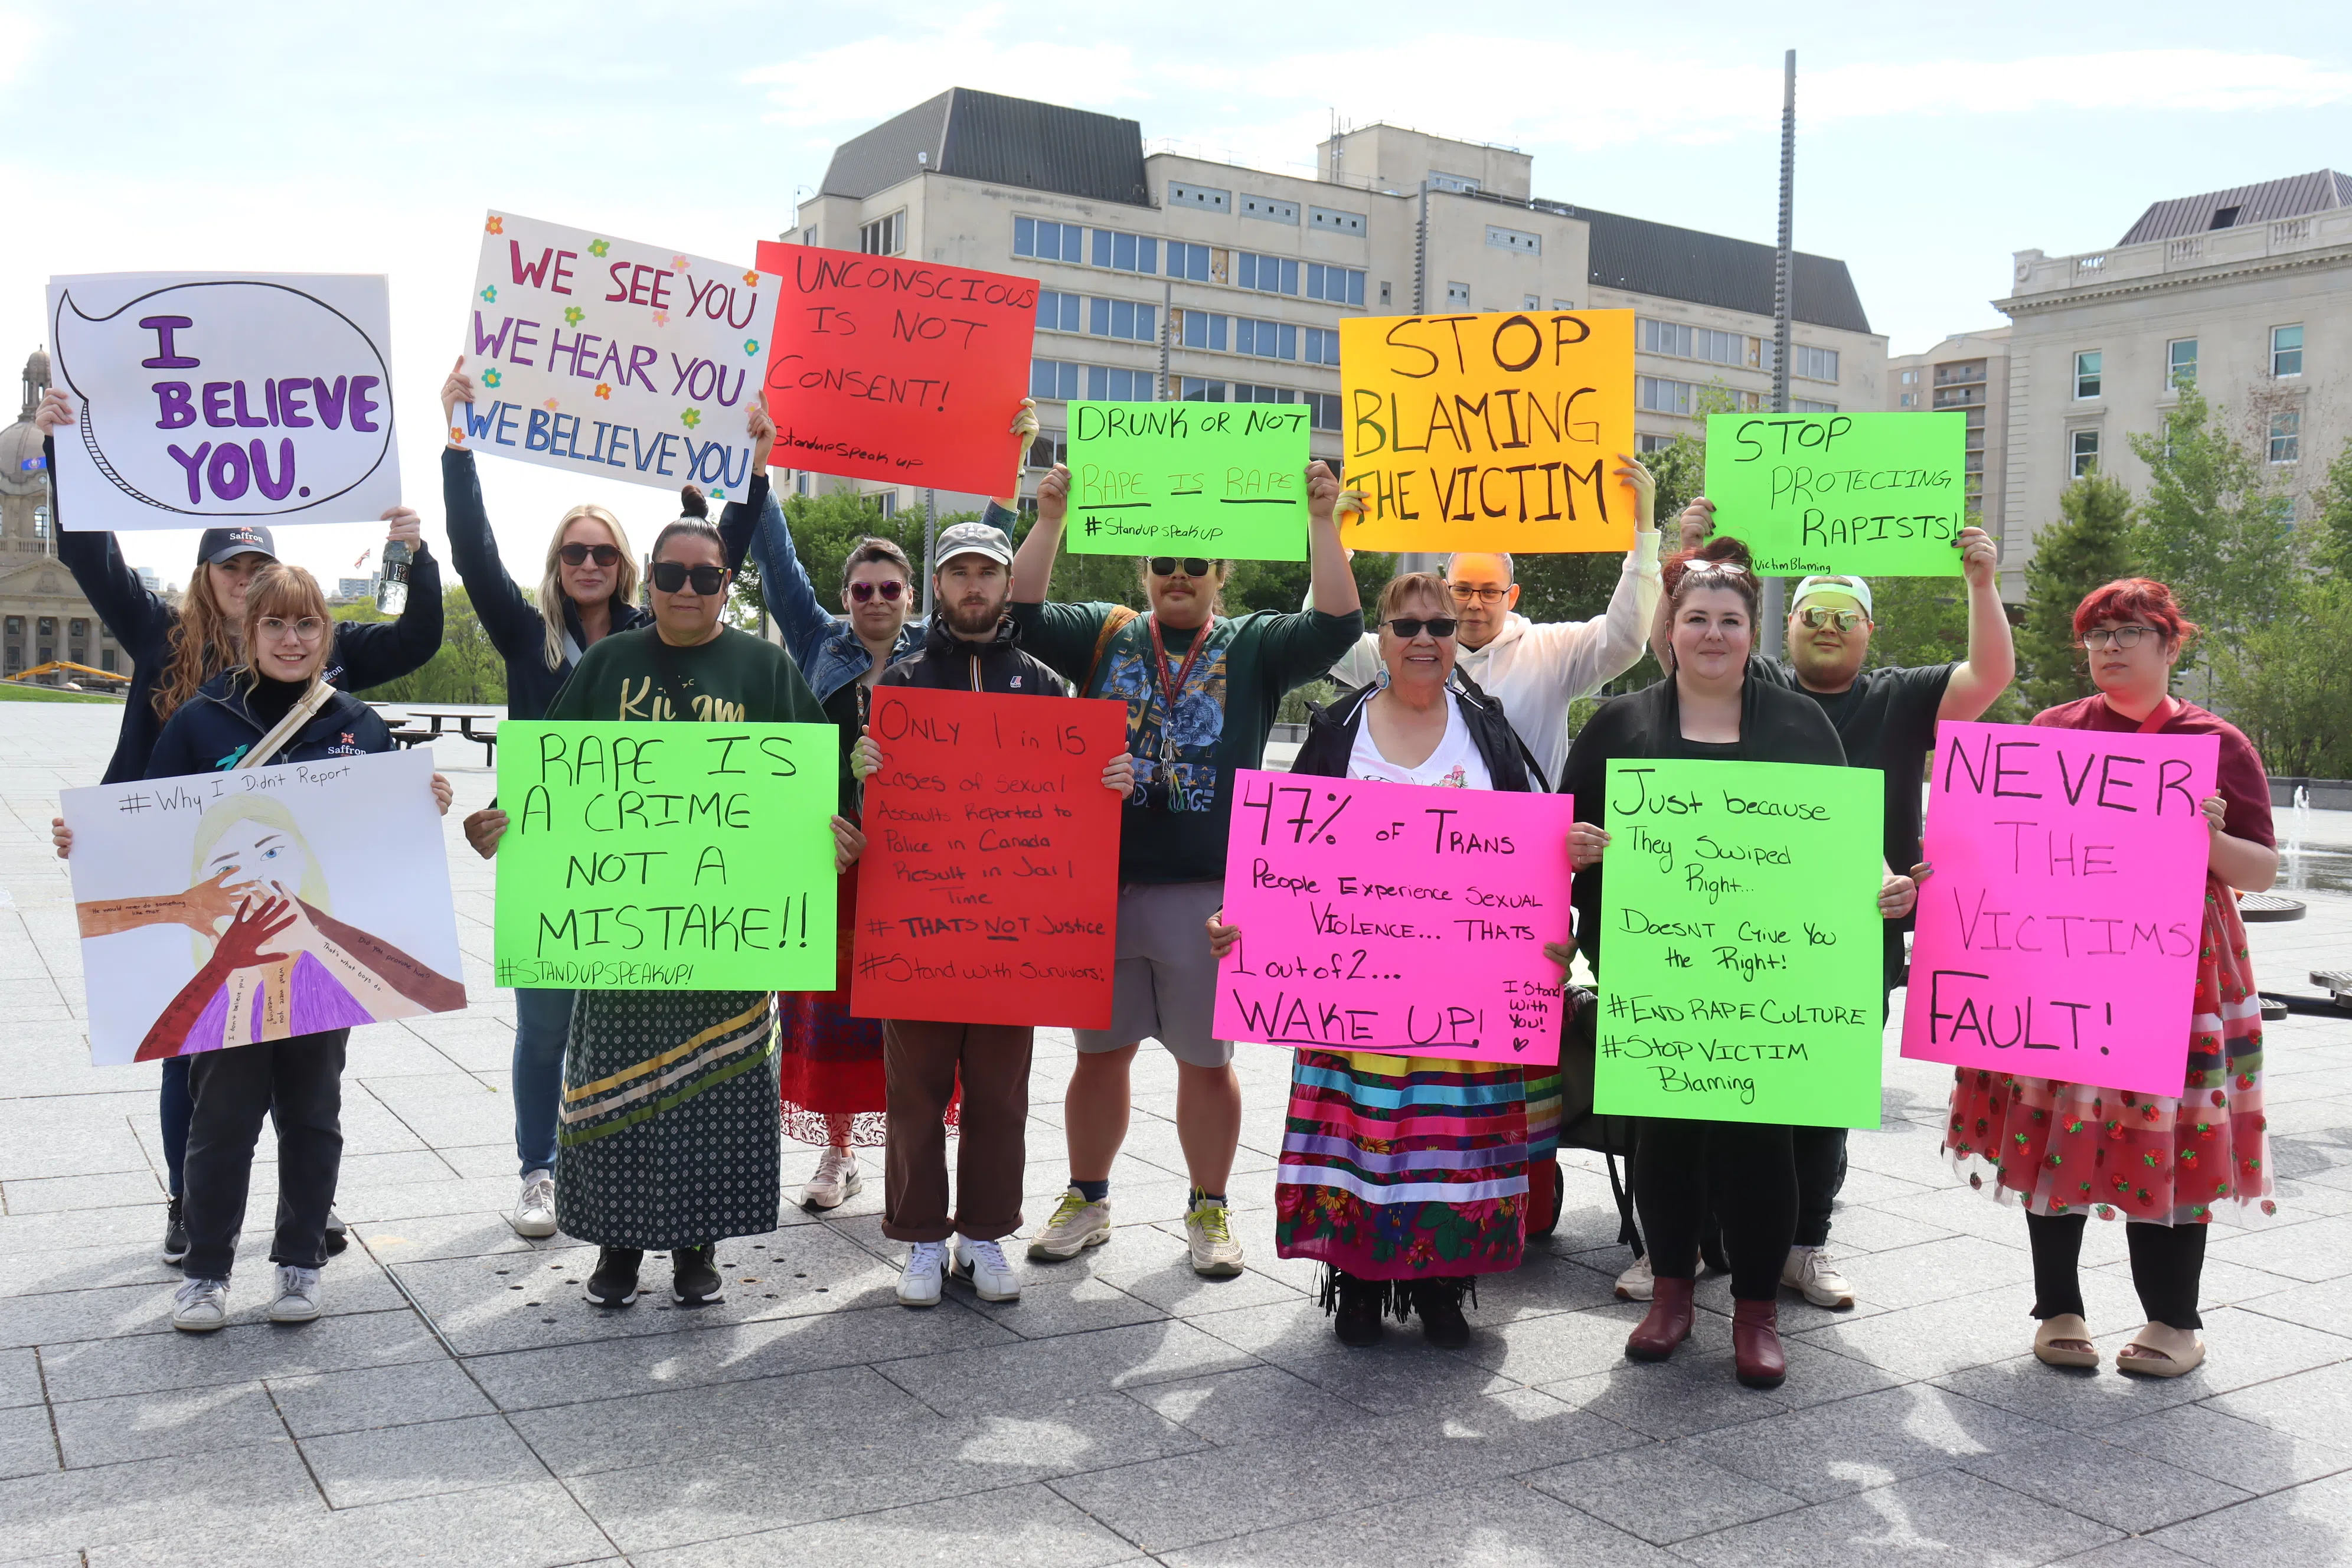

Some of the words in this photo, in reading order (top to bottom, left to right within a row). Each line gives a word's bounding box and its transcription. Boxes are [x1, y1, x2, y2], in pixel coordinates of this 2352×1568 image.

[509, 239, 578, 296] WE
[605, 261, 675, 310] SEE
[686, 274, 757, 329] YOU
[796, 255, 1035, 309] UNCONSCIOUS
[139, 315, 201, 368] I
[806, 306, 856, 335] IS
[893, 309, 989, 350] NOT
[1386, 314, 1591, 378] STOP
[474, 310, 541, 367] WE
[548, 328, 658, 393] HEAR
[671, 352, 746, 407] YOU
[767, 354, 950, 412] CONSENT!
[151, 374, 380, 433] BELIEVE
[1077, 406, 1188, 441] DRUNK
[1201, 411, 1231, 435] OR
[1244, 409, 1308, 436] NOT
[1353, 387, 1600, 458] BLAMING
[465, 400, 522, 446] WE
[525, 408, 681, 476] BELIEVE
[683, 436, 750, 489] YOU
[1733, 416, 1853, 462] STOP
[167, 437, 311, 505] YOU.
[1082, 463, 1148, 505] RAPE
[1167, 472, 1205, 492] IS
[1226, 466, 1296, 496] RAPE
[1346, 469, 1420, 527] THE
[1429, 458, 1610, 525] VICTIM
[230, 532, 264, 543] Saffron
[1802, 508, 1958, 548] RAPISTS!
[328, 744, 367, 756] Saffron
[879, 699, 961, 747] ONLY
[1056, 723, 1086, 756] 15
[211, 779, 225, 798] I
[296, 764, 352, 788] Report
[539, 733, 665, 792] RAPE
[706, 736, 797, 777] IS
[959, 772, 983, 792] of
[1944, 733, 2196, 817] NEVER
[521, 785, 551, 835] A
[584, 790, 752, 833] CRIME
[877, 800, 952, 823] Assaults
[1054, 803, 1073, 818] to
[1243, 779, 1353, 846] 47%
[1723, 789, 1832, 822] because
[883, 828, 933, 854] Police
[948, 837, 966, 851] in
[978, 828, 1051, 852] Canada
[1625, 825, 1674, 874] They
[1694, 835, 1792, 866] Swiped
[1993, 820, 2118, 877] THE
[566, 851, 669, 889] NOT
[694, 845, 727, 887] A
[982, 865, 1002, 878] in
[1252, 858, 1322, 894] People
[1337, 876, 1453, 901] Experience
[155, 900, 187, 909] something
[537, 891, 809, 959] MISTAKE!!
[984, 916, 1031, 935] NOT
[1953, 886, 2195, 958] VICTIMS
[323, 941, 339, 958] That's
[340, 958, 356, 972] what
[357, 971, 372, 984] boys
[1664, 946, 1694, 969] the
[1711, 945, 1788, 982] Right!
[1232, 988, 1379, 1043] WAKE
[1407, 1004, 1484, 1049] UP!
[1928, 969, 2113, 1056] FAULT!
[1646, 1065, 1755, 1106] Blaming
